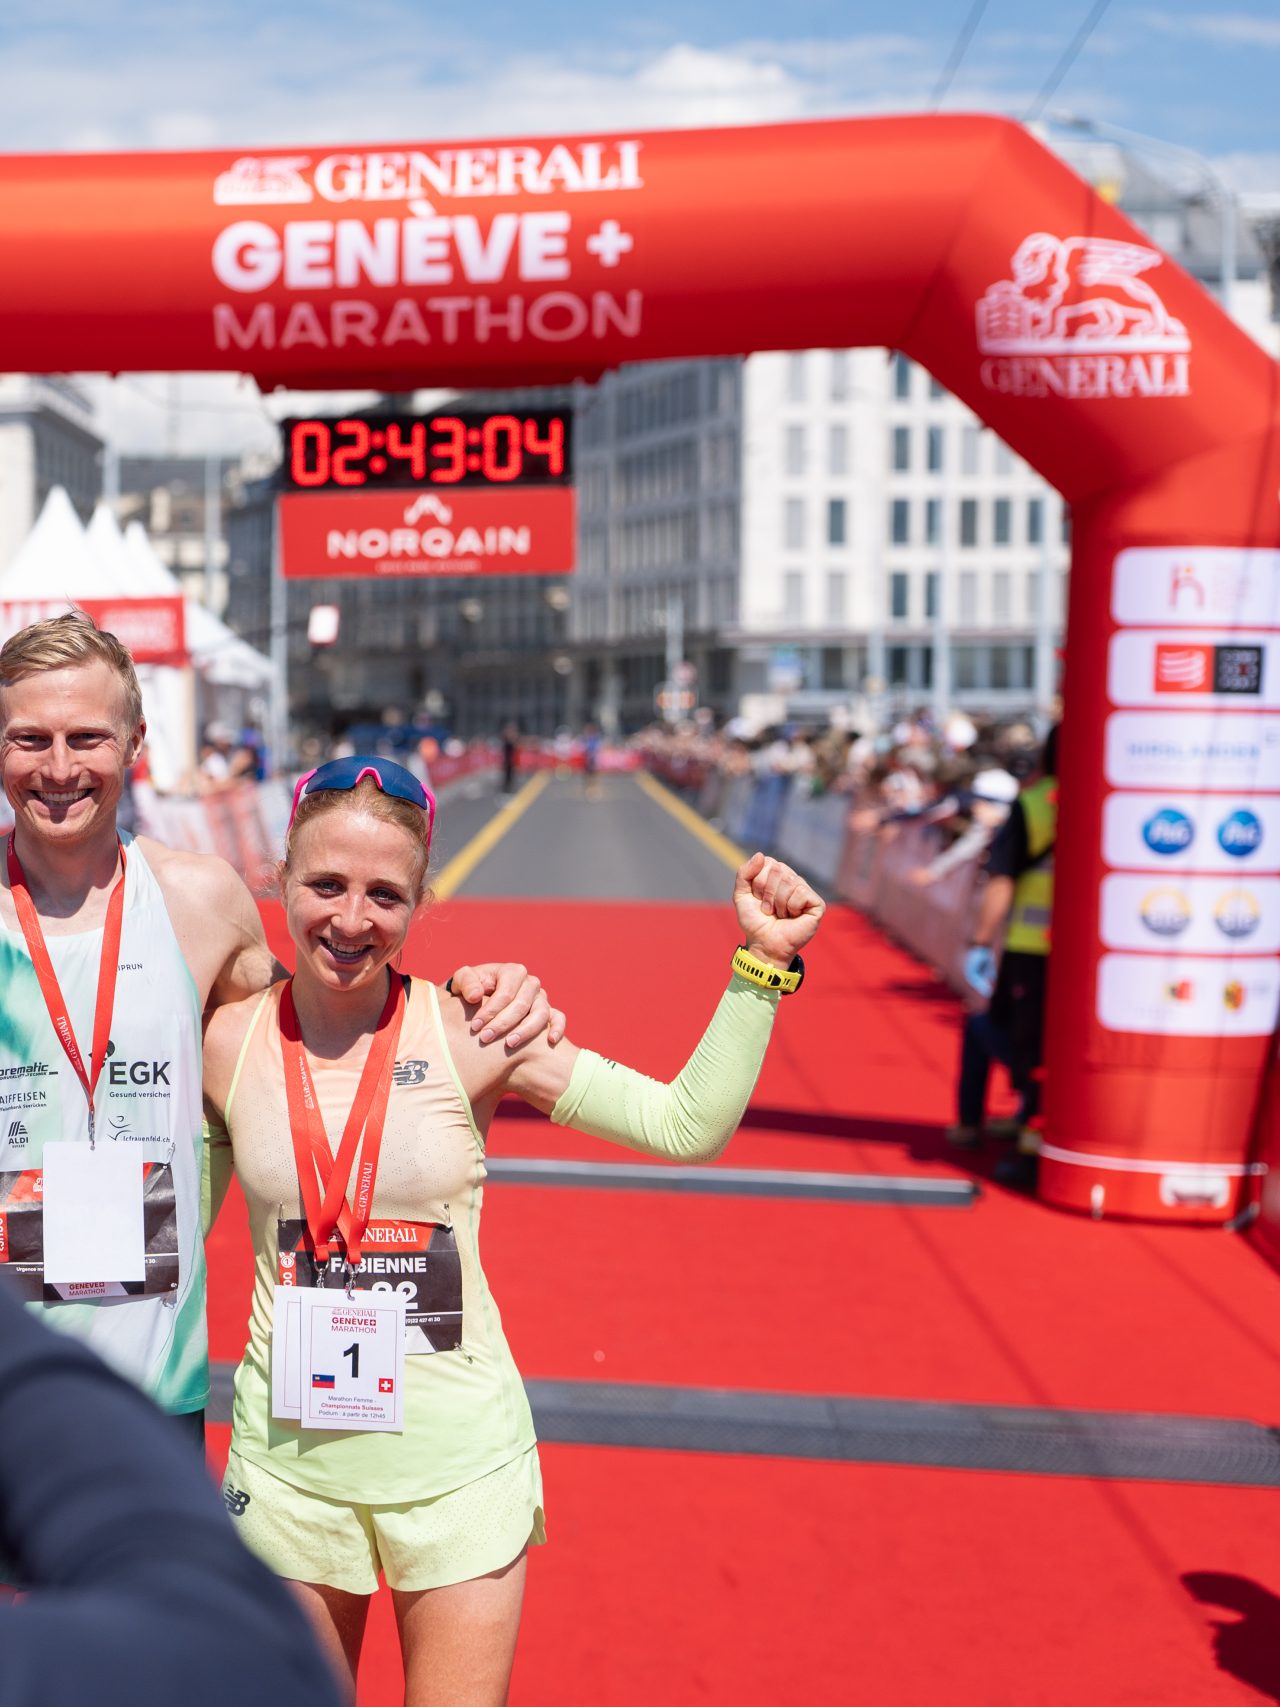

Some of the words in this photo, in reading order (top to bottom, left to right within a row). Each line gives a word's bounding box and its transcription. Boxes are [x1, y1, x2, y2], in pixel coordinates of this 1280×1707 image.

[314, 141, 644, 202] GENERALI
[212, 200, 571, 292] GENÈVE
[213, 290, 642, 349] MARATHON
[980, 354, 1191, 399] GENERALI
[291, 415, 565, 487] 02:43:04
[327, 526, 531, 560] NORQAIN
[109, 1061, 170, 1085] EGK
[358, 1162, 373, 1208] GENERALI
[69, 1288, 106, 1297] MARATHON
[331, 1325, 377, 1334] MARATHON
[332, 1316, 369, 1326] GENÈVE
[342, 1309, 376, 1317] GENERALI
[343, 1343, 359, 1378] 1
